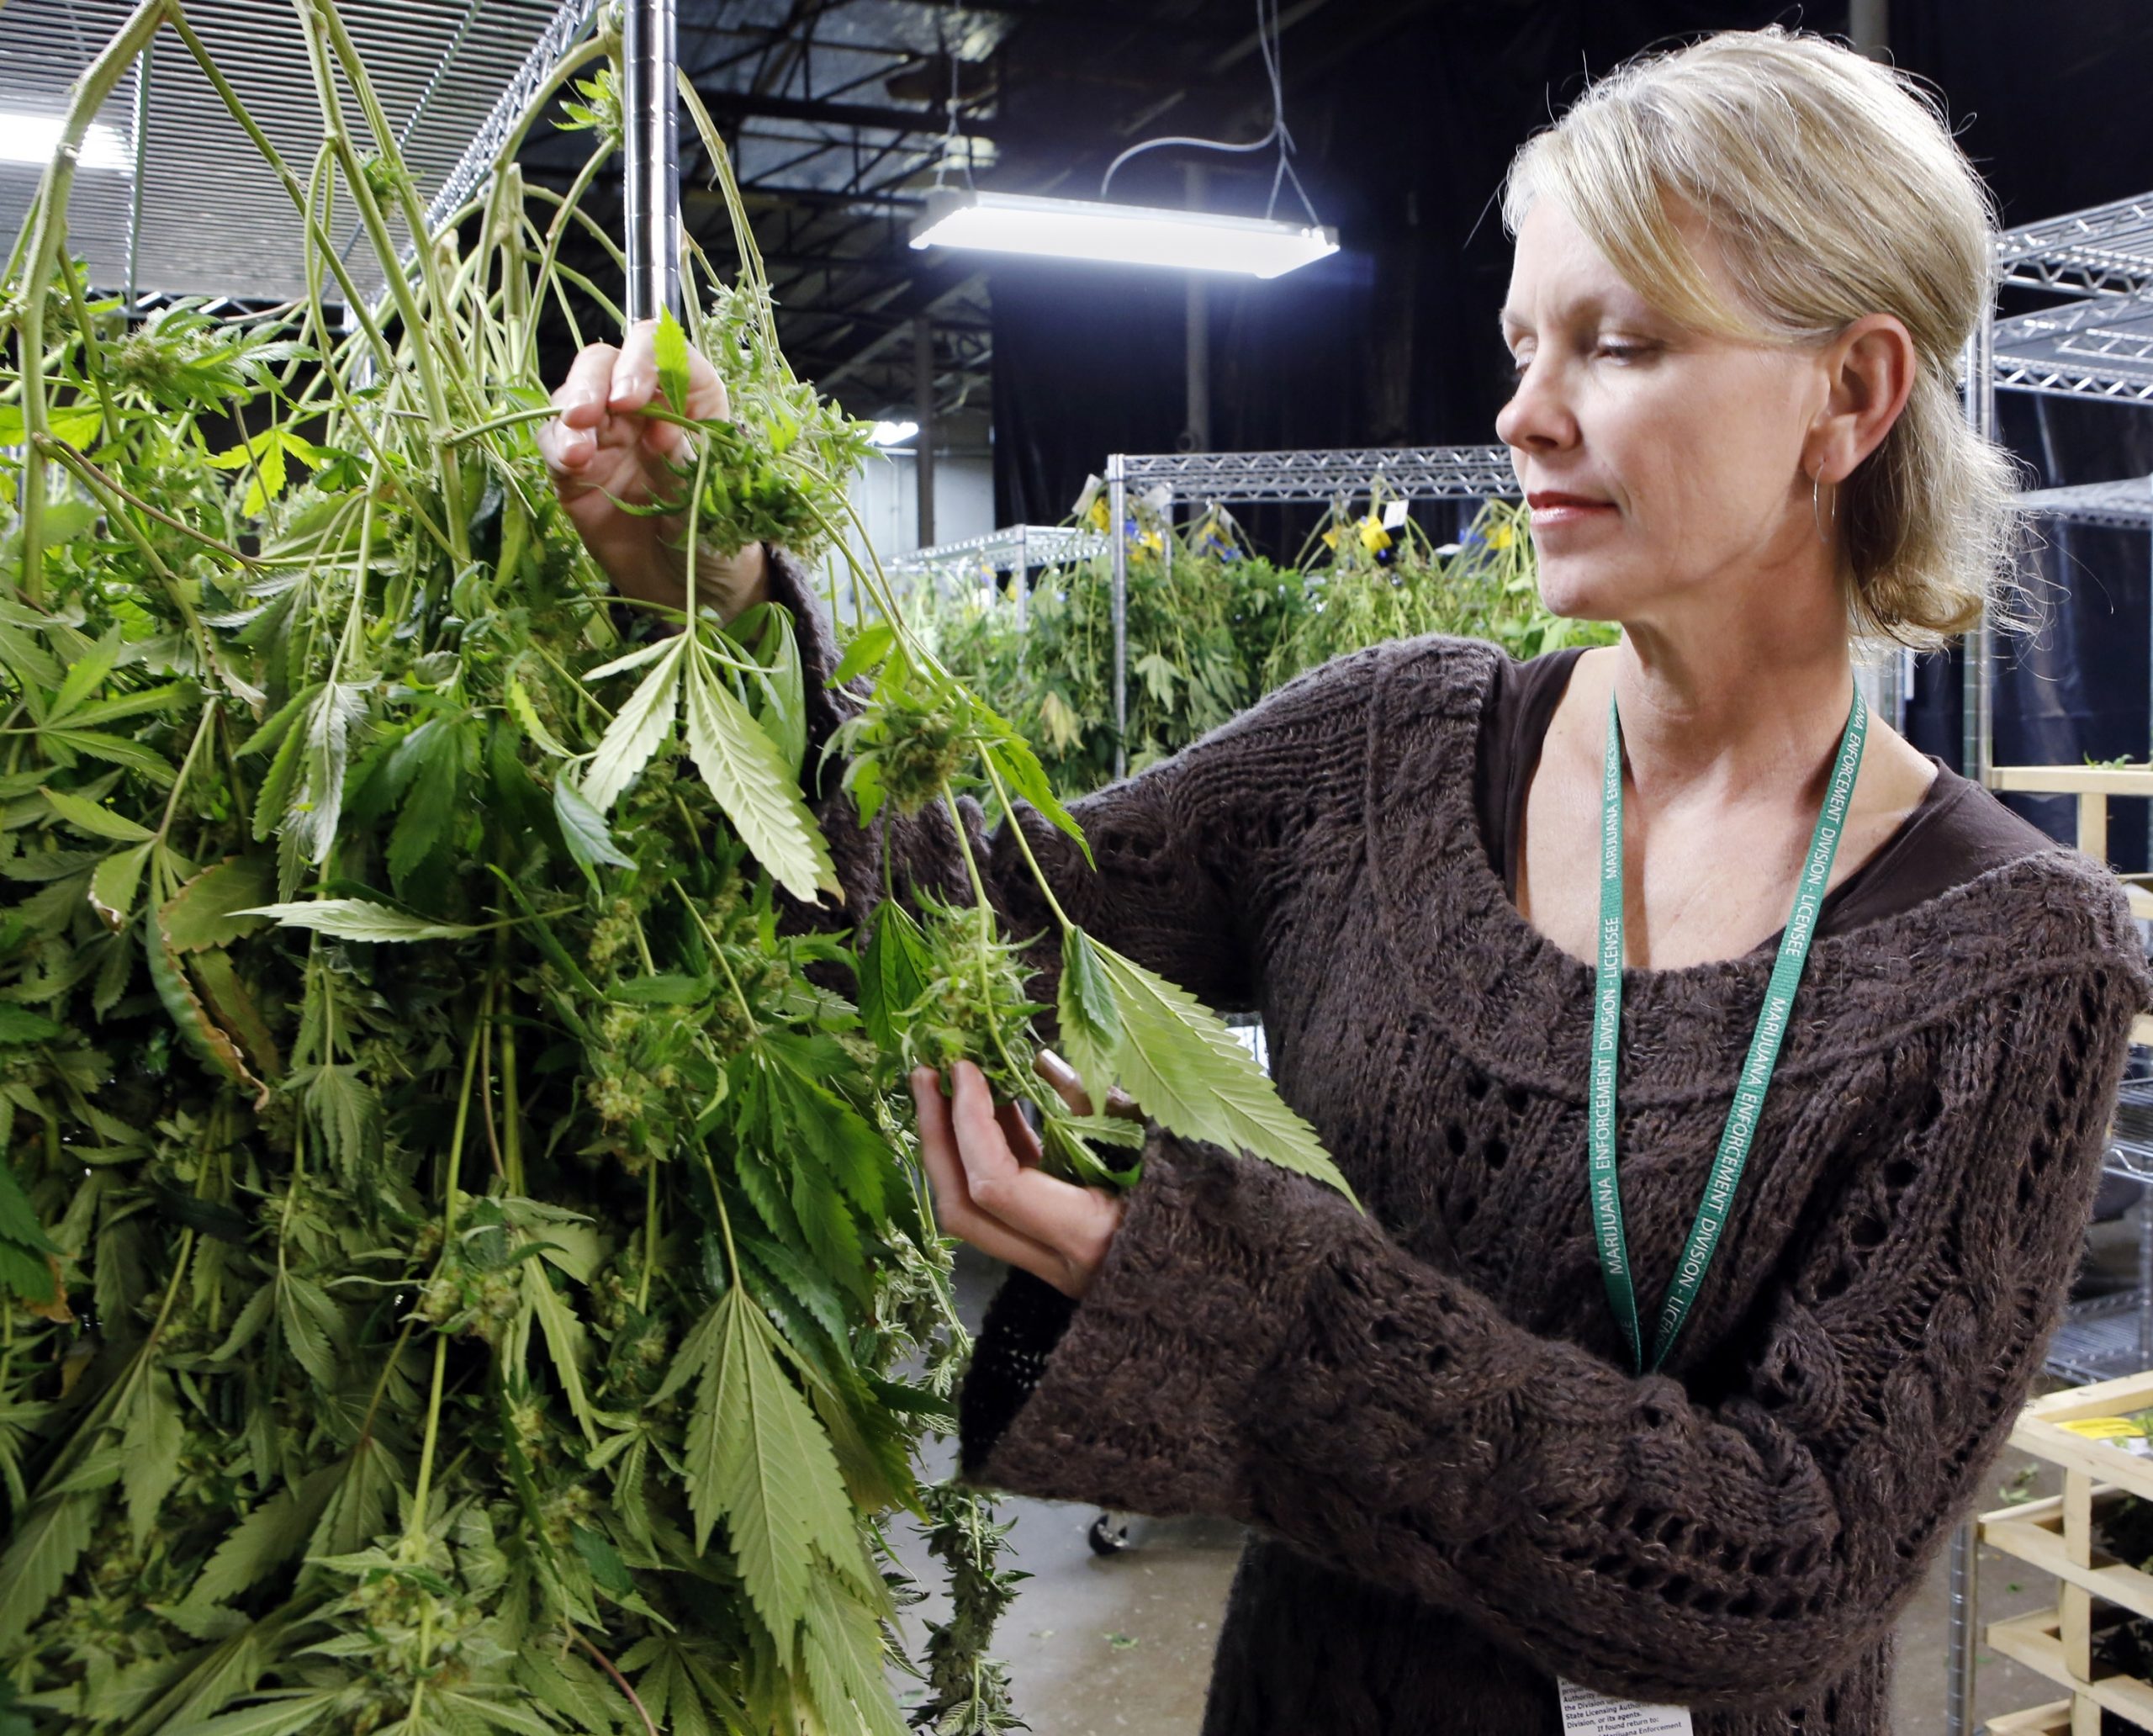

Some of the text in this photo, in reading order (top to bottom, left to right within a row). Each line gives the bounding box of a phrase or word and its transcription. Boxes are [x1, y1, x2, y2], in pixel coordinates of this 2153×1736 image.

[1825, 733, 1860, 824] ENFORCEMENT
[1605, 804, 1619, 880] MARIJUANA
[1807, 828, 1837, 886] DIVISION
[1604, 917, 1620, 978] LICENSEE
[1785, 894, 1817, 958] LICENSEE
[1599, 989, 1617, 1052] DIVISION
[1747, 997, 1786, 1086] MARIJUANA
[1595, 1057, 1613, 1170] ENFORCEMENT
[1716, 1092, 1758, 1215] ENFORCEMENT
[1600, 1177, 1624, 1275] MARIJUANA
[1682, 1216, 1717, 1289] DIVISION
[1563, 1692, 1595, 1703] Authority
[1566, 1712, 1584, 1720] State
[1585, 1706, 1617, 1717] Licensing
[1578, 1700, 1605, 1710] Division
[1605, 1722, 1625, 1730] found
[1626, 1717, 1648, 1727] return
[1639, 1721, 1682, 1734] Enforcement
